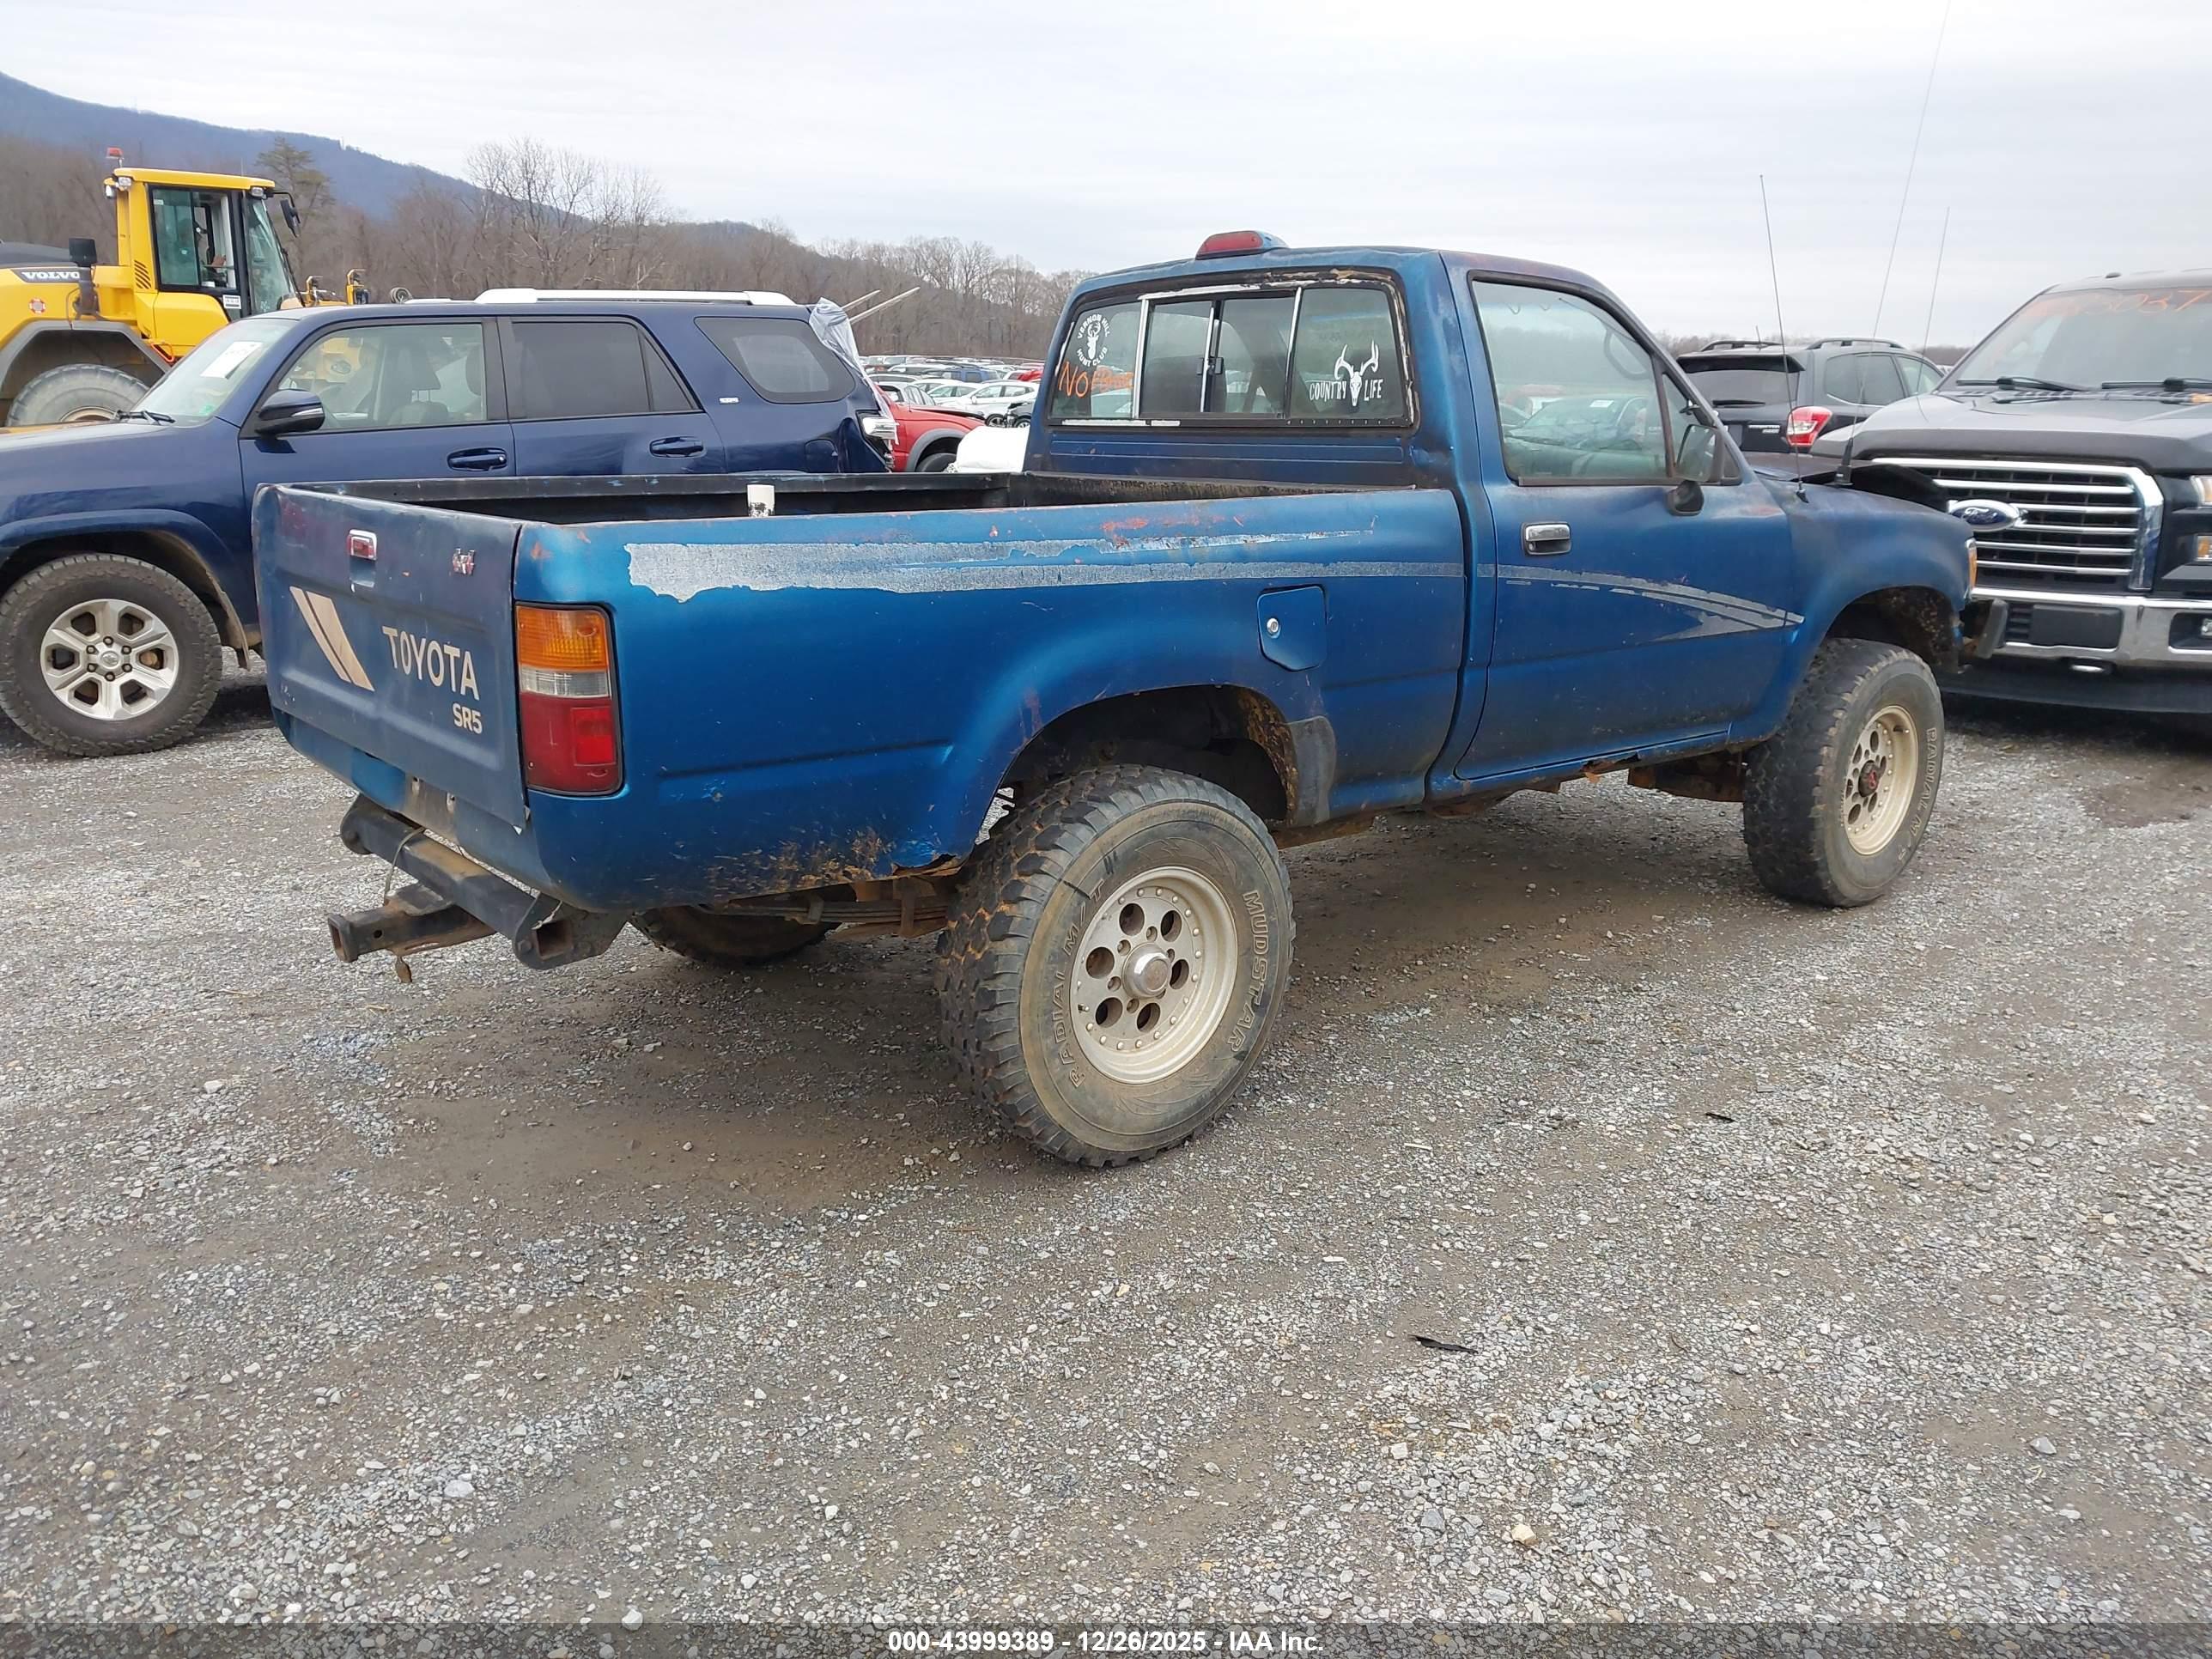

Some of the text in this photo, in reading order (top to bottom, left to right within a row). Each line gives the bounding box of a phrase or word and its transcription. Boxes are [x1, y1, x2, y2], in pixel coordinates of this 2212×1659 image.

[1077, 313, 1110, 338] VERNON HILL
[1076, 346, 1108, 367] HUNT CLUB
[1309, 379, 1383, 402] COUNTRY LIFE
[382, 625, 480, 701] TOYOTA
[453, 702, 483, 734] SR5
[1917, 727, 1938, 811] RADIAL
[1226, 890, 1269, 1052] MUDSTAR
[1053, 970, 1085, 1088] RADIAL
